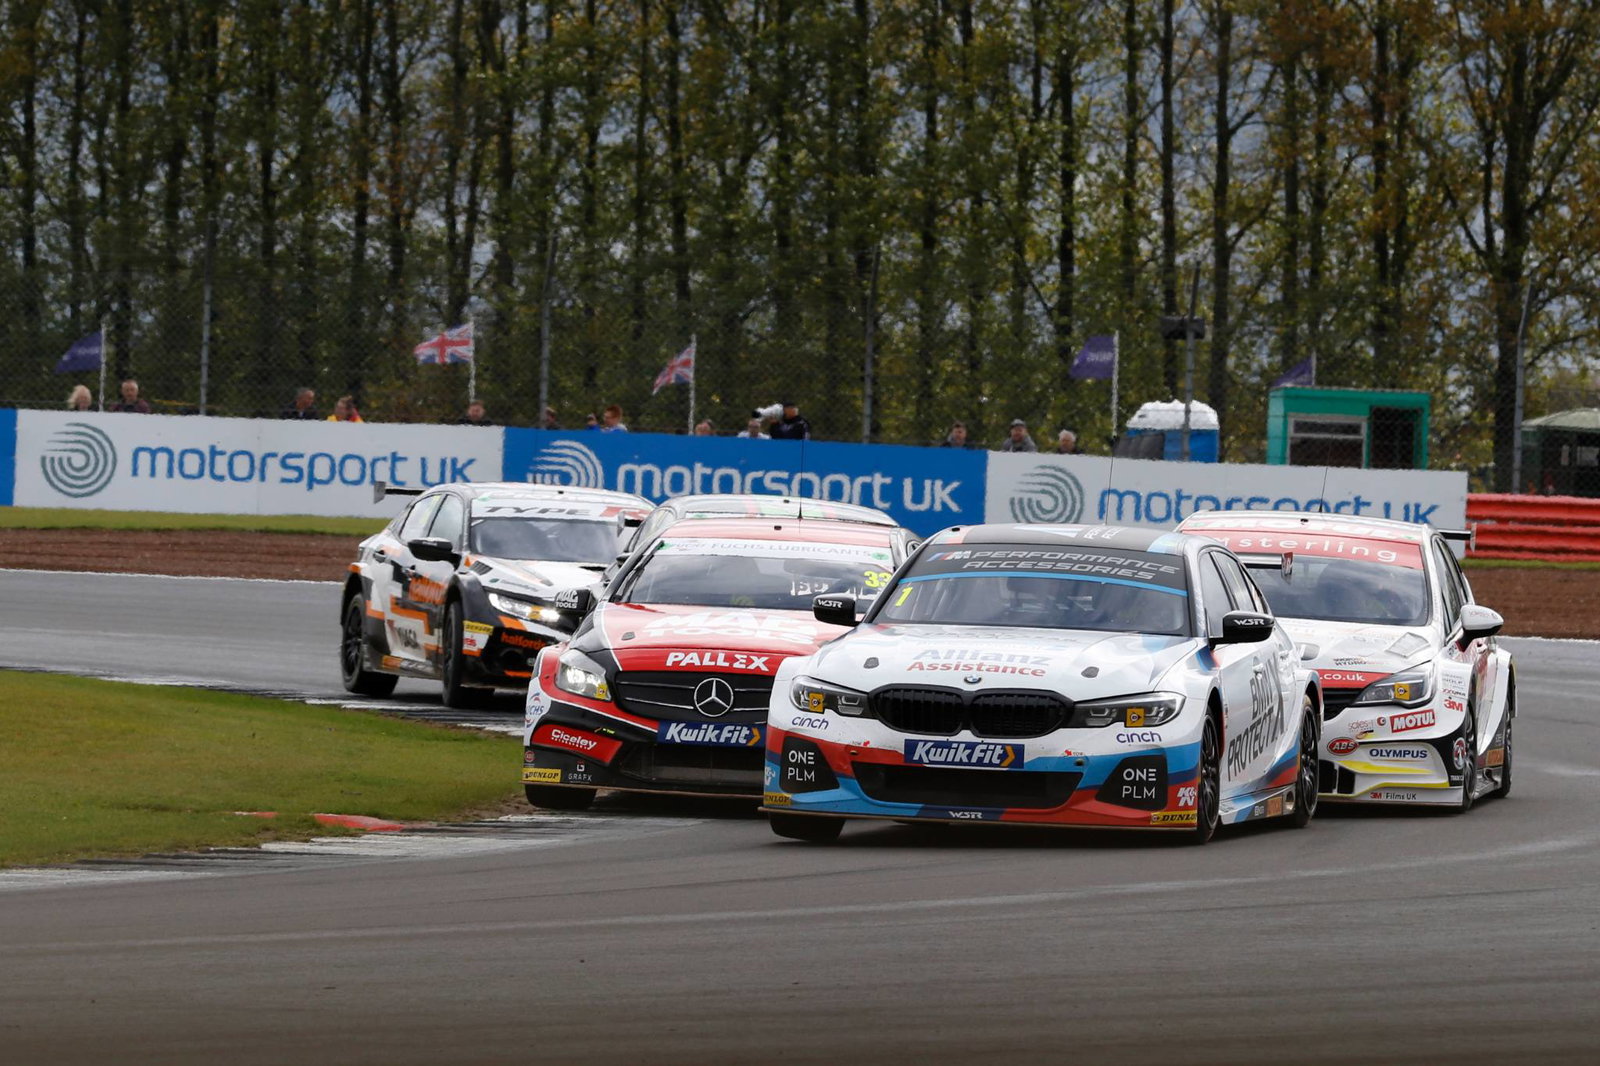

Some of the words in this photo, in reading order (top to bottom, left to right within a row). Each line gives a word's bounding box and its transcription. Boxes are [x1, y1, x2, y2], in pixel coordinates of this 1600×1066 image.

[131, 445, 408, 491] motorsport
[484, 506, 592, 515] TYPE
[971, 550, 1180, 574] PERFORMANCE
[962, 560, 1157, 580] ACCESSORIES
[864, 570, 892, 588] 33
[895, 586, 913, 607] 1
[555, 601, 577, 609] TOOLS
[817, 599, 843, 609] WSR
[1233, 618, 1265, 626] WSR
[912, 649, 1050, 667] Allianz
[906, 661, 1046, 678] Assistance
[1444, 700, 1464, 712] 3M
[791, 716, 829, 730] cinch
[1393, 711, 1435, 731] MOTUL
[551, 728, 597, 750] Ciceley
[1116, 731, 1162, 743] cinch
[1227, 706, 1275, 782] PROTECT
[788, 750, 815, 765] ONE
[1369, 748, 1428, 759] OLYMPUS
[528, 771, 559, 779] DUNLOP
[787, 767, 815, 782] PLM
[1122, 768, 1157, 781] ONE
[1121, 785, 1156, 799] PLM
[1385, 792, 1406, 800] Films
[1406, 792, 1417, 800] UK
[948, 811, 983, 819] WSR
[1161, 813, 1197, 822] DUNLO
